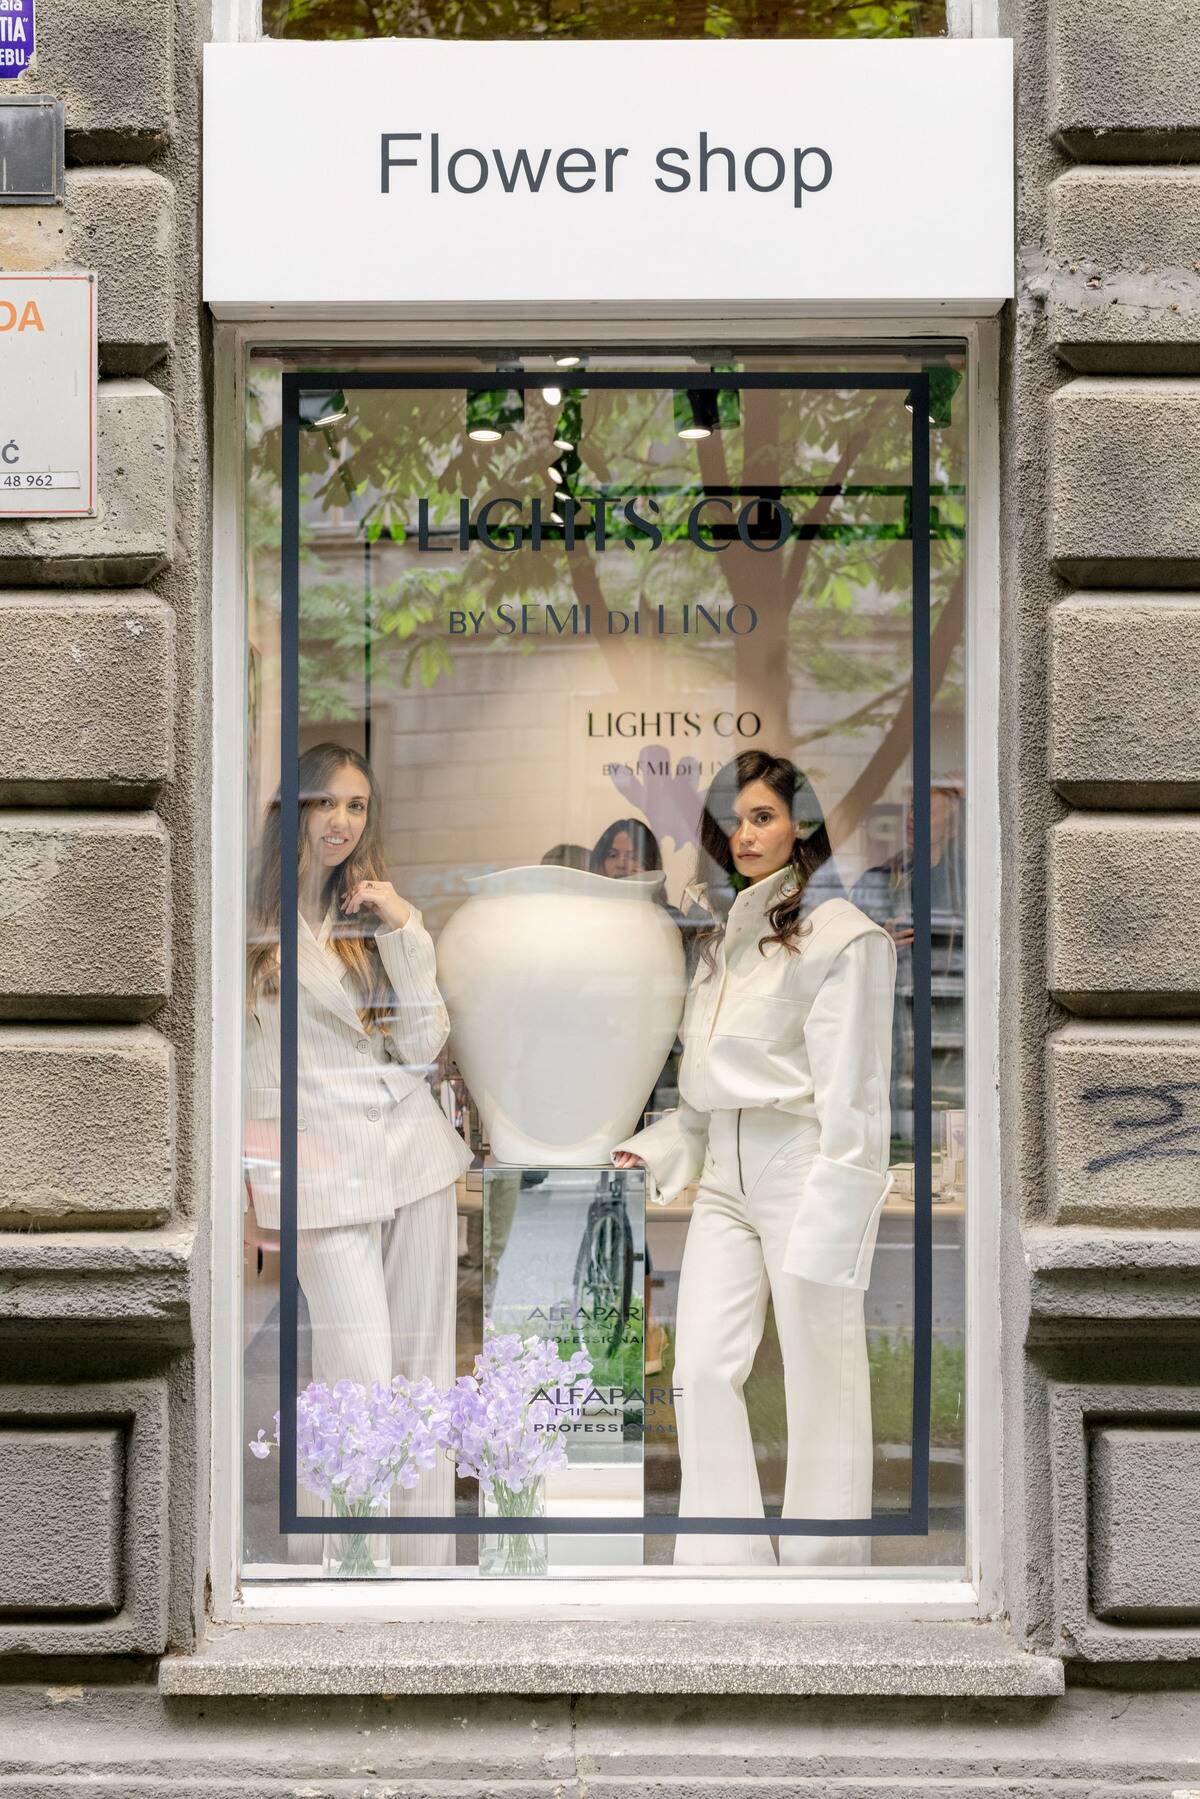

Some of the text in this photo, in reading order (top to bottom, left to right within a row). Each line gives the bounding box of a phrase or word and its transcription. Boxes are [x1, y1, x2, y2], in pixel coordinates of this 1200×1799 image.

[381, 131, 833, 209] Flower shop
[3, 474, 53, 487] 48 962
[418, 498, 793, 552] LIGHTS CO
[449, 604, 758, 635] BY SEMI DI LINO
[588, 711, 762, 737] LIGHTS CO
[602, 763, 620, 776] BY
[527, 1306, 643, 1321] ALFAPAR
[528, 1387, 684, 1405] ALFAPARF
[554, 1407, 656, 1417] MILANO
